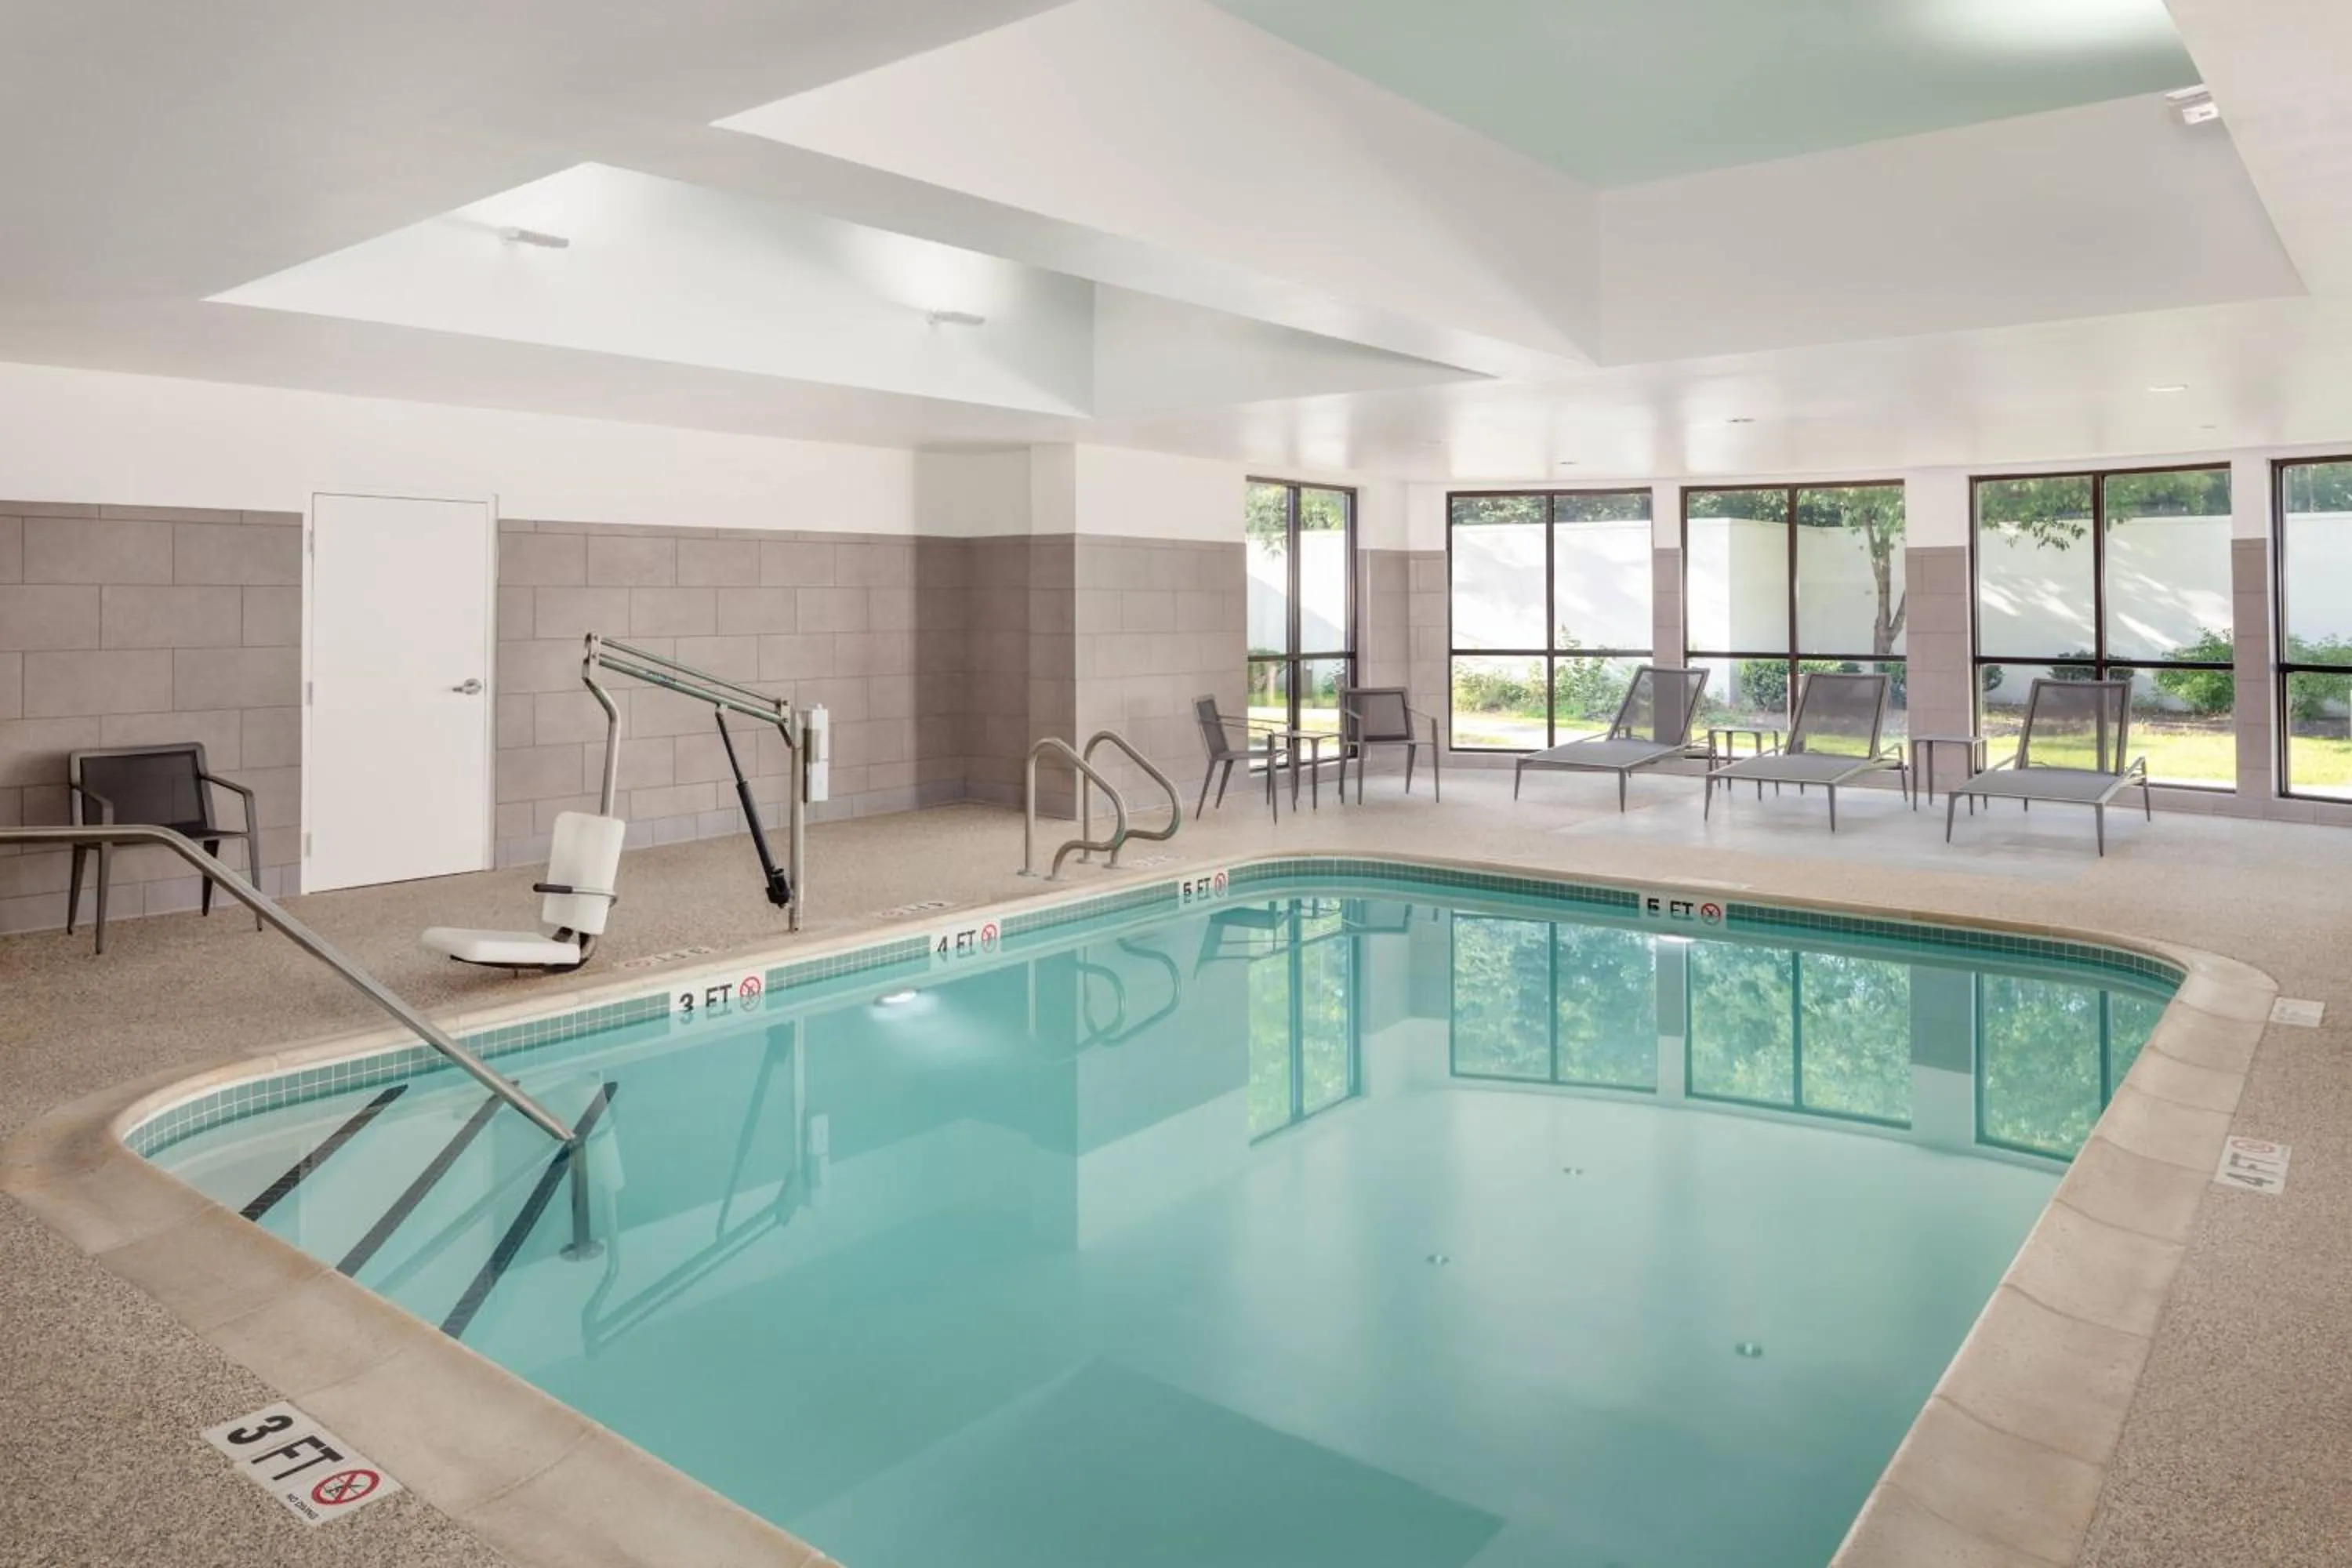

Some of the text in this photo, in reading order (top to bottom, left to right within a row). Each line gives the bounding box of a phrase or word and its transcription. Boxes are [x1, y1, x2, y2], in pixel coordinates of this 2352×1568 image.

[1197, 877, 1211, 894] FT
[1647, 898, 1694, 916] 5 FT
[937, 929, 976, 953] 4 FT
[679, 983, 732, 1012] 3 FT
[2225, 1152, 2280, 1187] 4 FT
[227, 1414, 344, 1481] 3 FT
